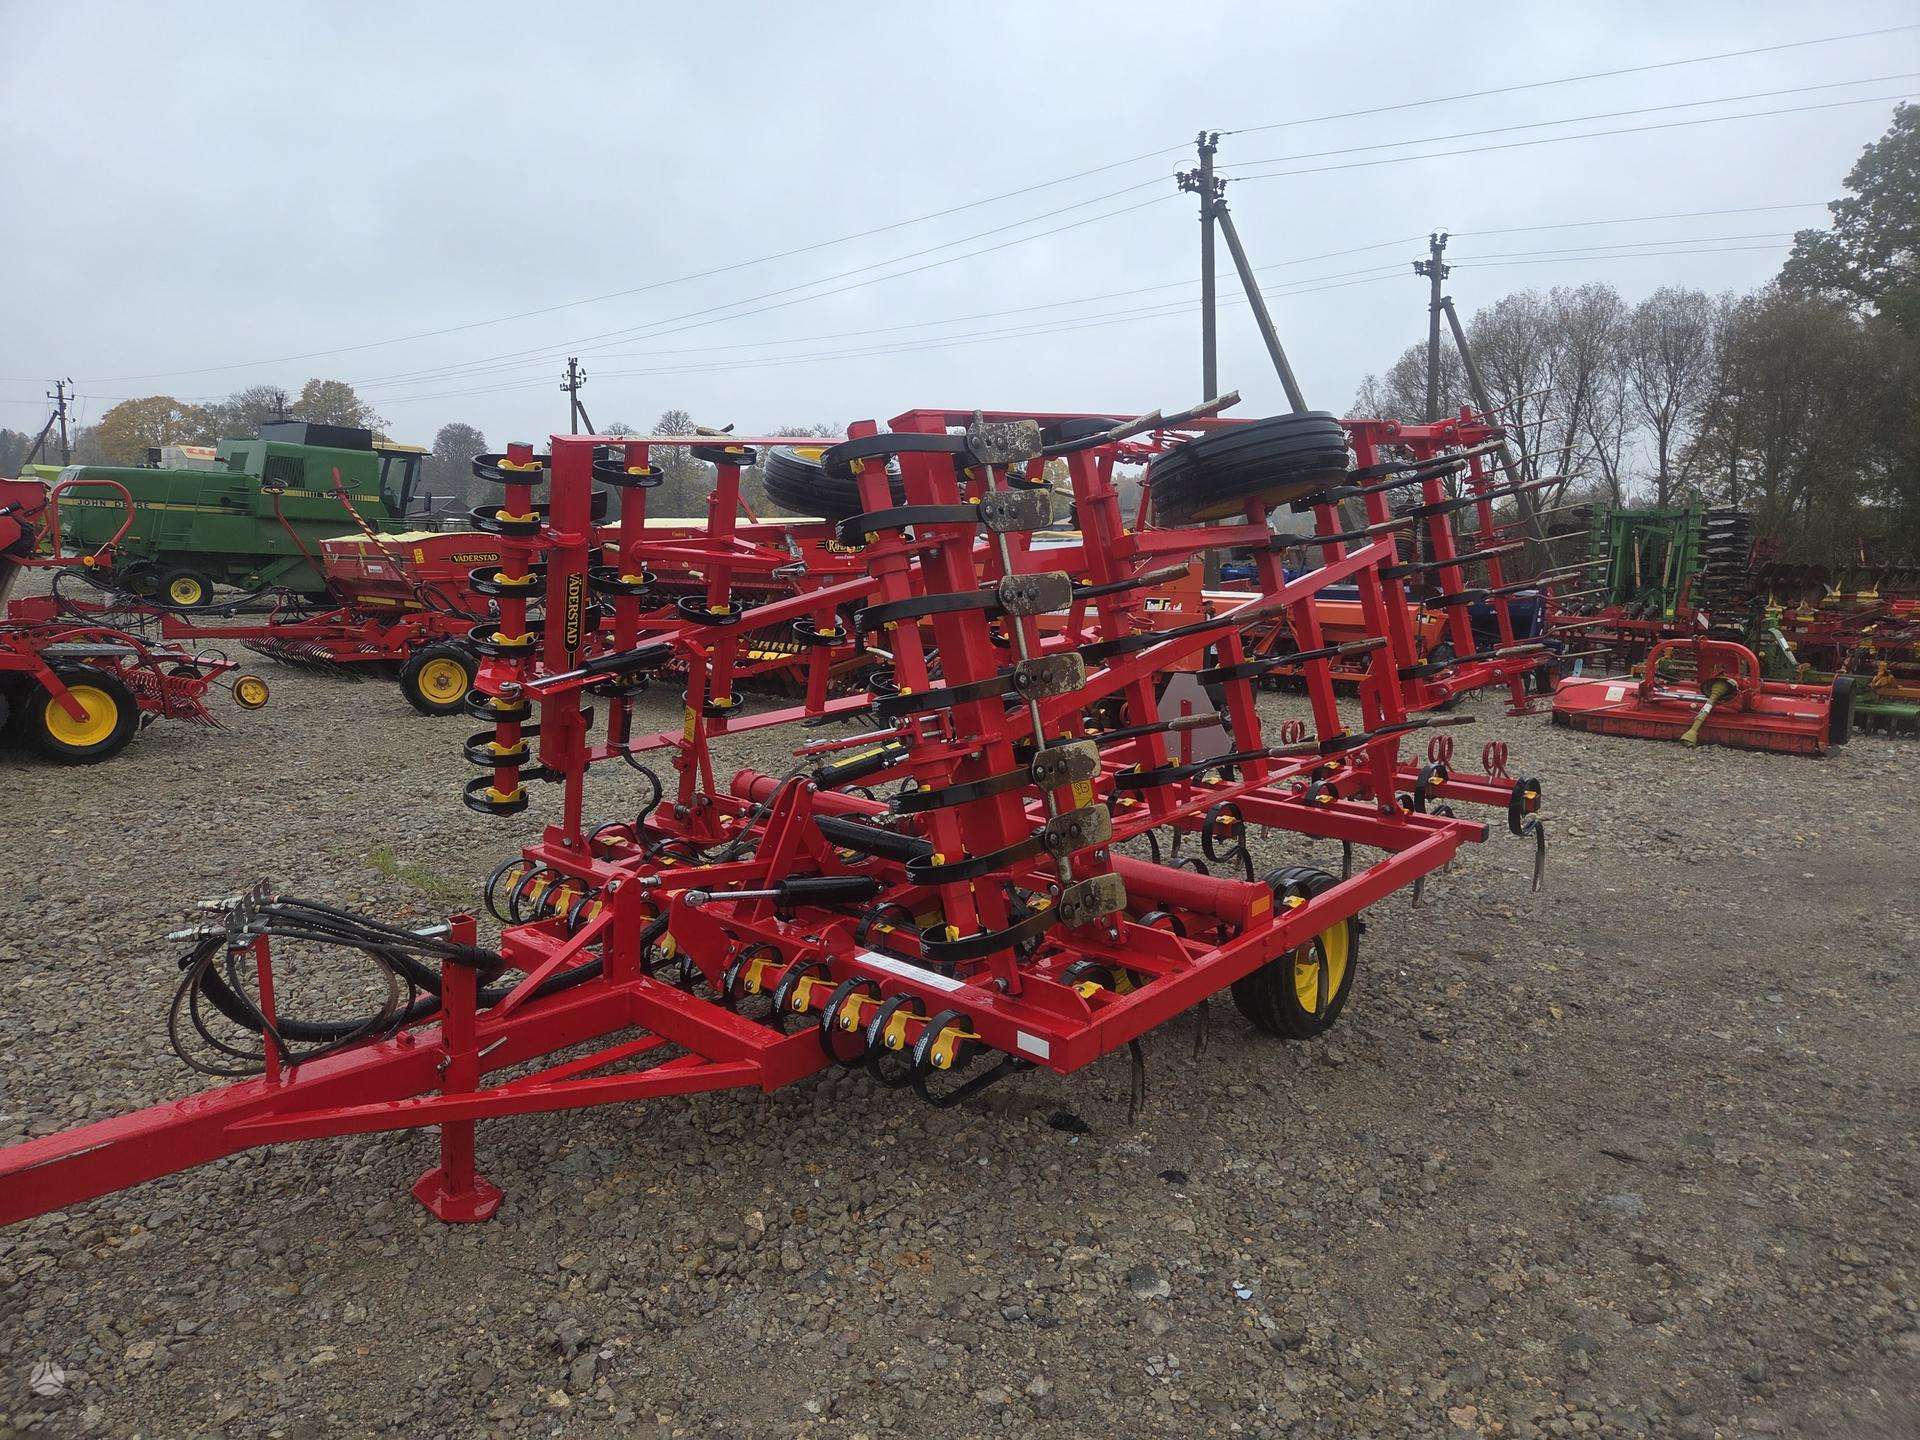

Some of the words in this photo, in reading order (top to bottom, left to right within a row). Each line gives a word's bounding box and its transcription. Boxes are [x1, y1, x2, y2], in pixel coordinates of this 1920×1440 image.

[78, 500, 106, 508] JOHN
[114, 502, 149, 510] DERE
[568, 573, 582, 644] VÄDERSTAD
